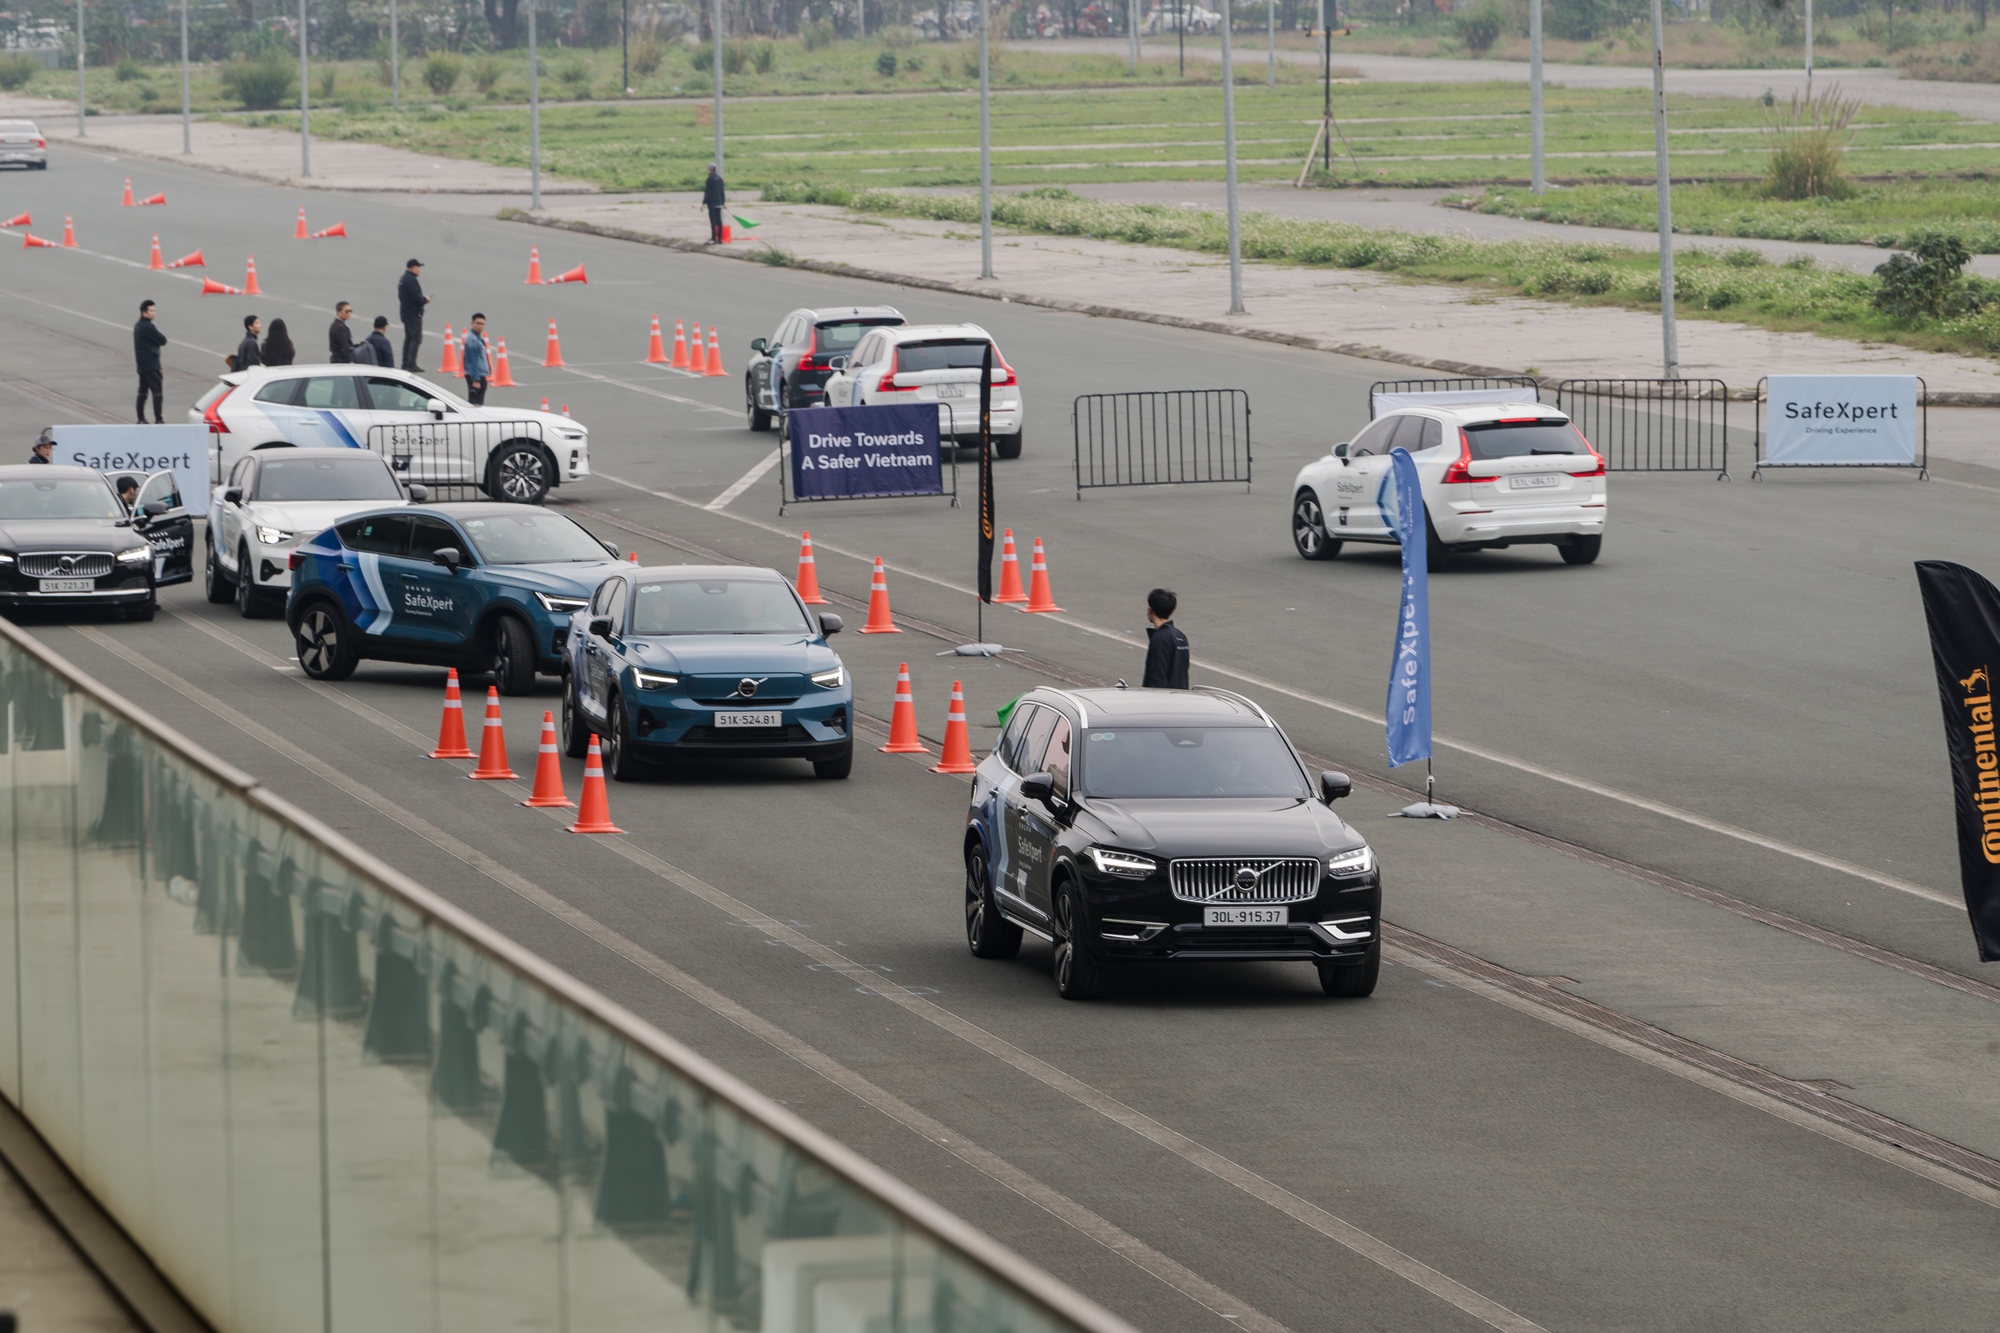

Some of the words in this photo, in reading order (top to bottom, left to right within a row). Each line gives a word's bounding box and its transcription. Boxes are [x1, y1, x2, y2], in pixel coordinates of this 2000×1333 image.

[1785, 401, 1898, 422] SafeXpert
[808, 433, 852, 448] Drive
[854, 430, 924, 447] Towards
[1805, 427, 1833, 435] Driving
[1835, 427, 1877, 435] Experience
[73, 452, 191, 471] SafeXpert
[801, 455, 815, 470] A
[818, 454, 861, 469] Safer
[863, 453, 933, 468] Vietnam
[44, 581, 90, 590] 51K-721.31
[405, 593, 453, 611] SafeXpert
[720, 715, 775, 725] 51K-524.81
[1964, 693, 2000, 864] Continental
[1212, 911, 1280, 922] 30L-915.37
